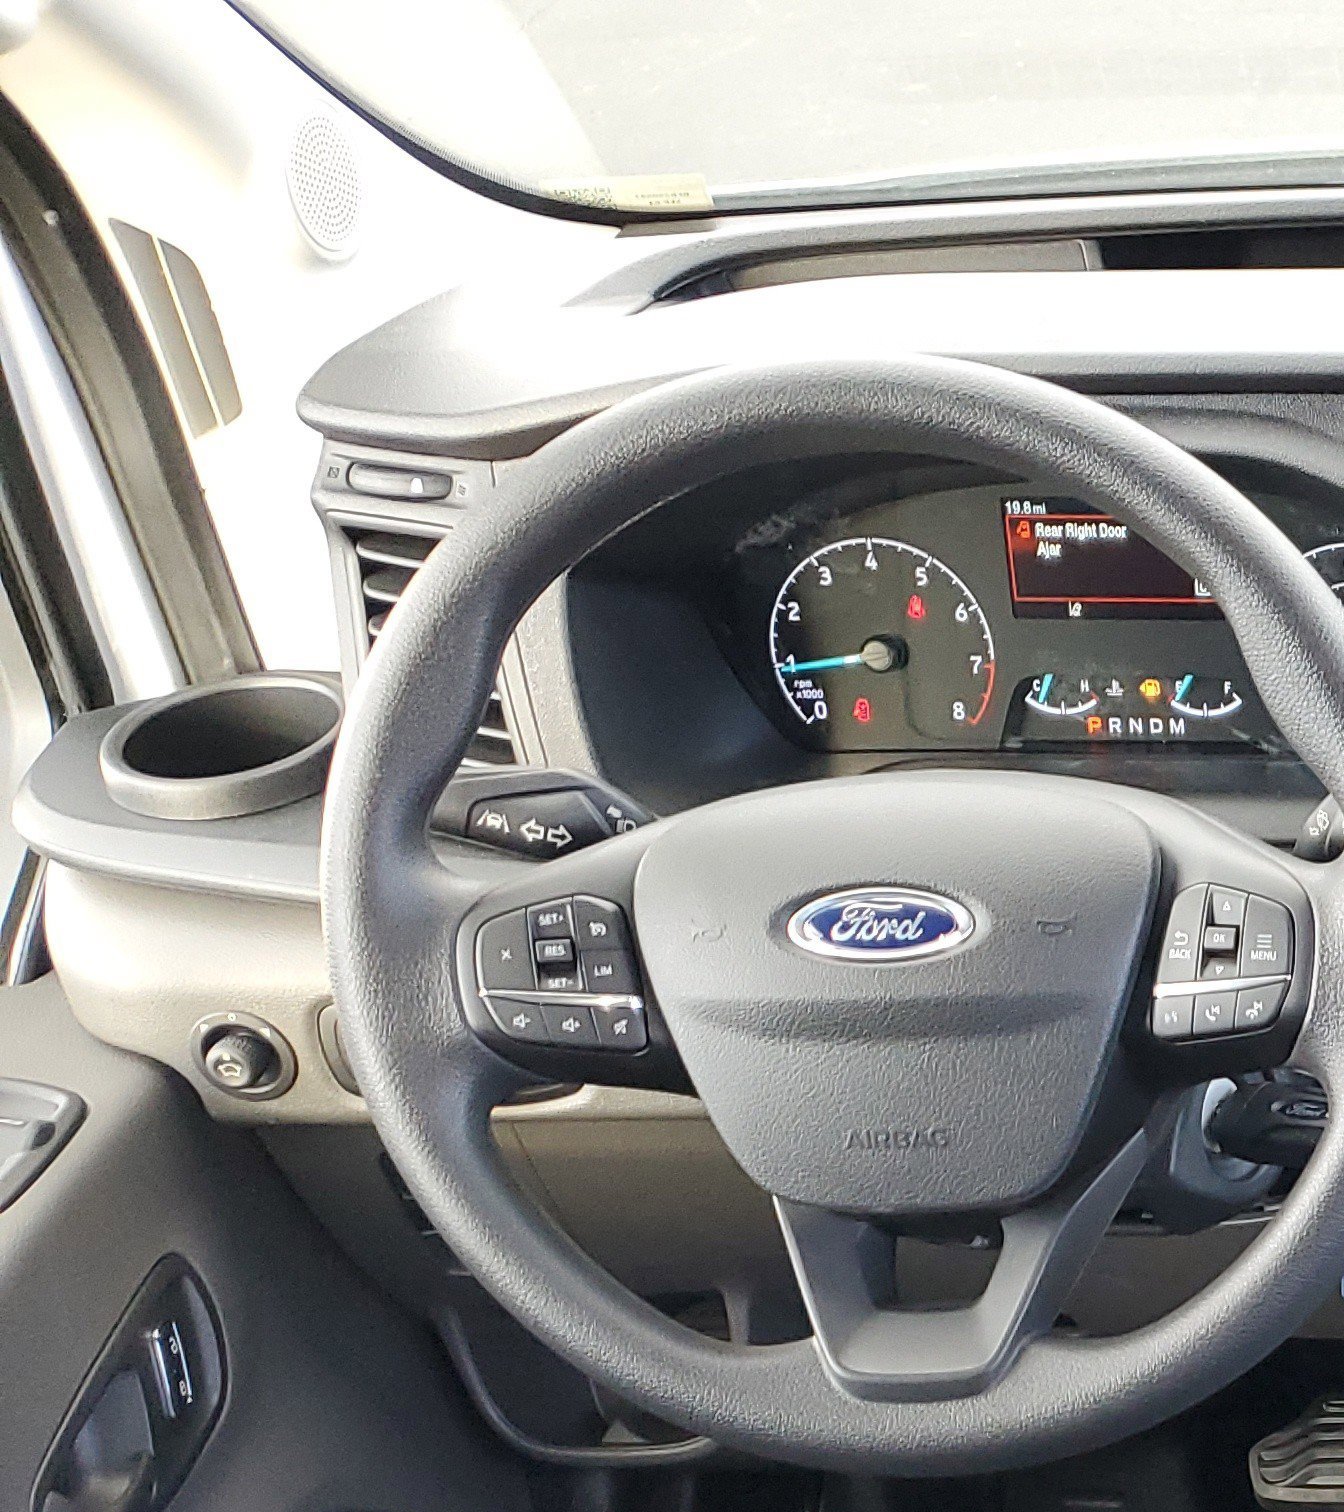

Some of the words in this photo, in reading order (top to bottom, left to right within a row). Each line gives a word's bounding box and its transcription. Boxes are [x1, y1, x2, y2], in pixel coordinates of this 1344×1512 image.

[1035, 523, 1063, 538] Rear
[1065, 523, 1097, 541] Right
[1099, 523, 1128, 538] Door
[1036, 542, 1062, 559] Ajar
[865, 551, 878, 570] 4
[818, 566, 832, 586] 3
[915, 566, 928, 586] 5
[787, 602, 800, 621] 2
[955, 602, 968, 622] 6
[970, 655, 982, 674] 7
[1080, 680, 1089, 692] H
[1223, 681, 1232, 693] F
[814, 701, 827, 719] 0
[952, 702, 965, 719] 8
[831, 901, 927, 941] Ford
[1213, 933, 1226, 943] OK
[1168, 949, 1191, 959] BACK
[1250, 950, 1277, 961] MENU
[843, 1128, 952, 1150] AIRBAG
